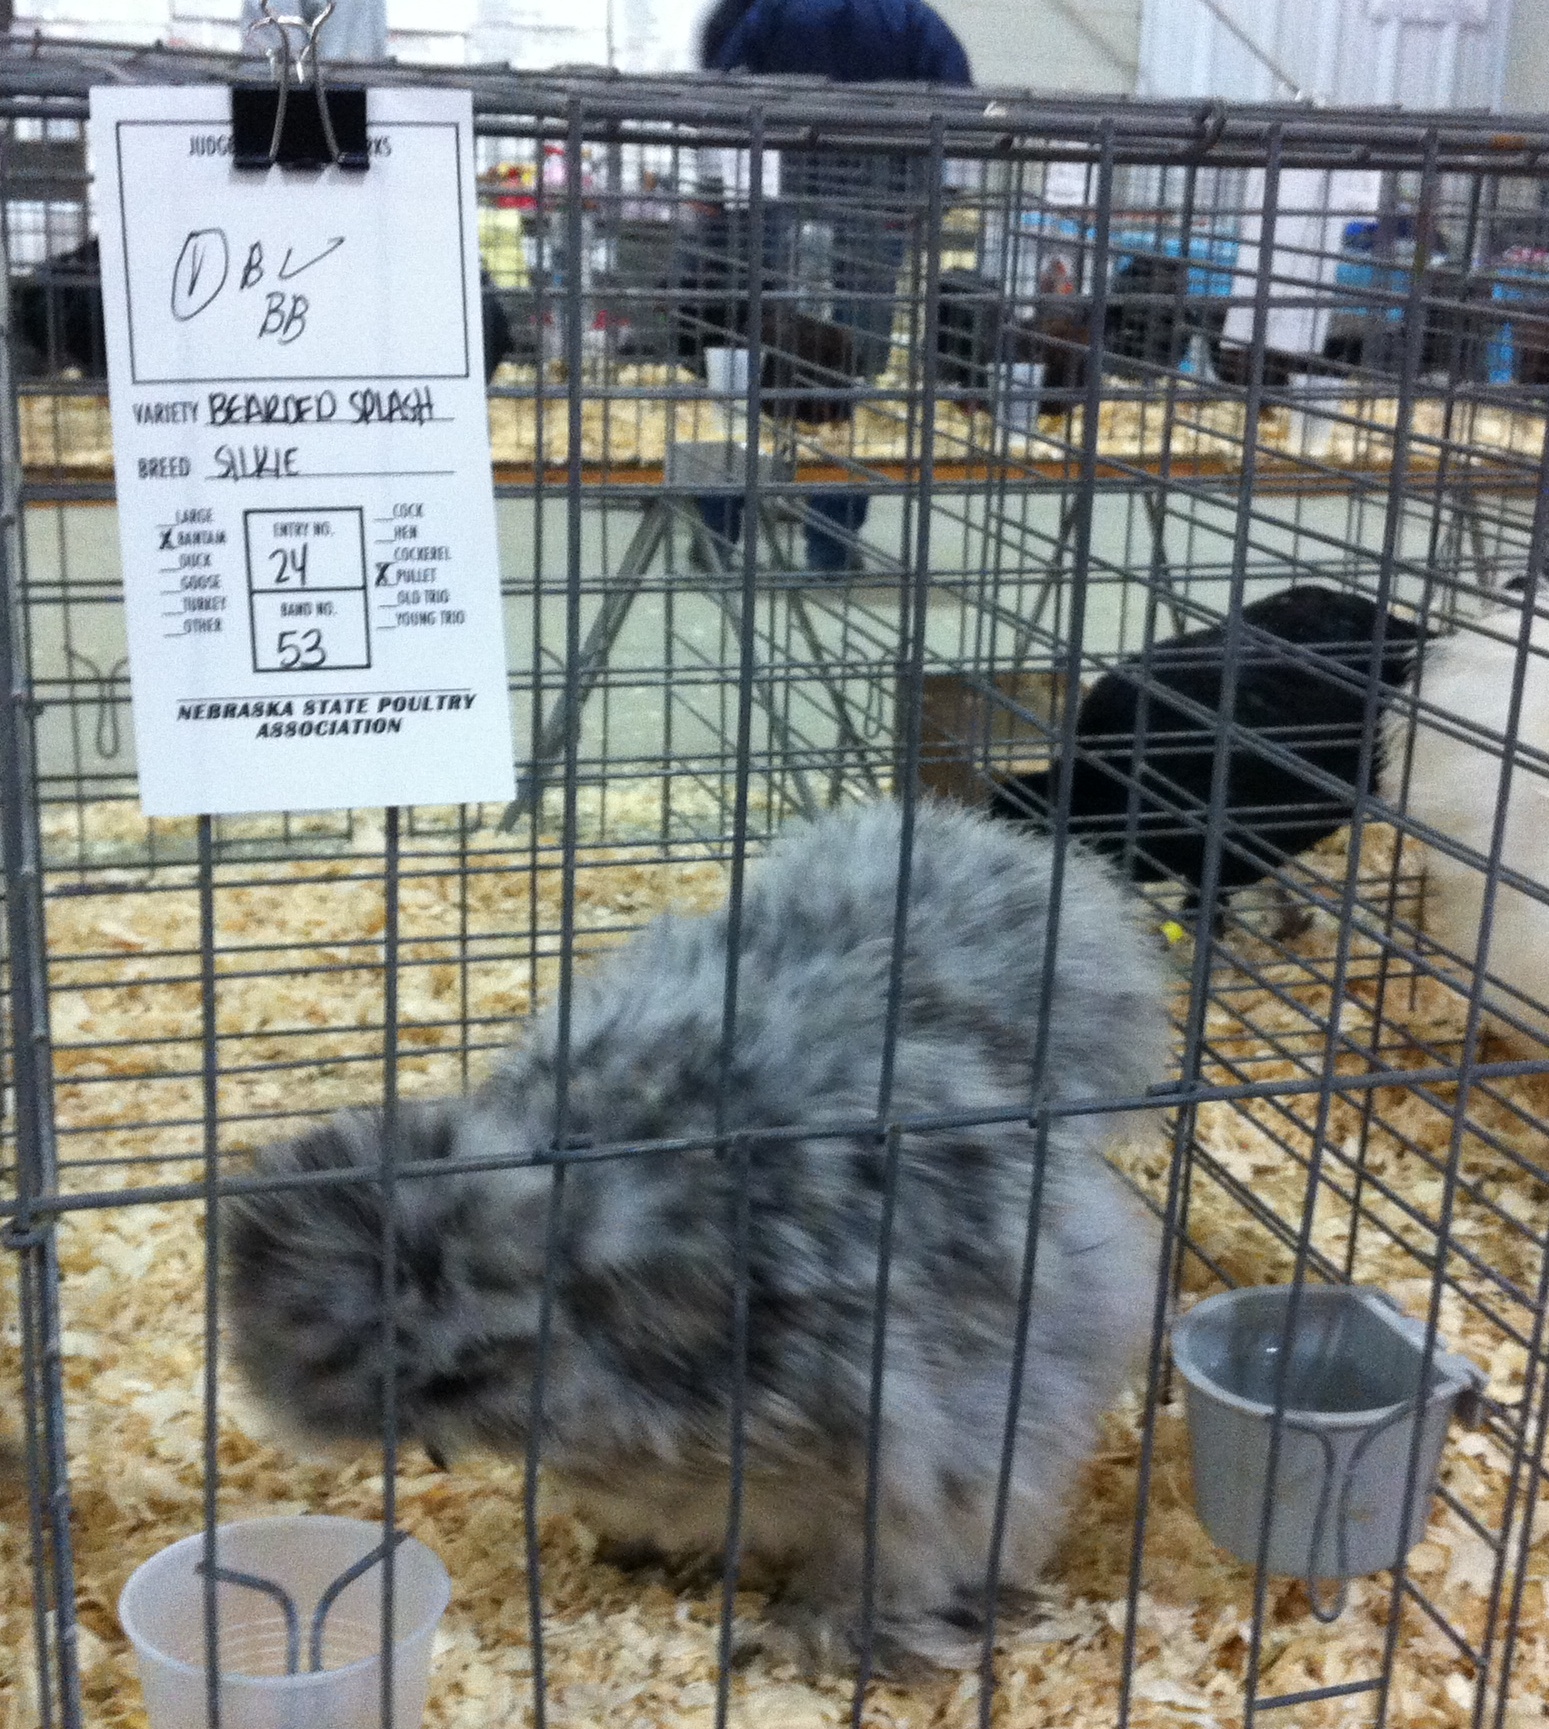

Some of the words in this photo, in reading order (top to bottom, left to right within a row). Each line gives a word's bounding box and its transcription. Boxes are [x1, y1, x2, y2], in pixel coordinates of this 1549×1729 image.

[258, 292, 309, 345] BB
[133, 402, 197, 424] VARIETY
[210, 392, 336, 426] BEARDED
[350, 387, 433, 426] SPLASH
[138, 458, 190, 478] BREED
[215, 445, 300, 480] SILKIE
[176, 509, 213, 523] LARGE
[393, 504, 423, 518] COCK
[274, 522, 310, 536] ENTRY
[394, 525, 417, 539] HEN
[178, 531, 226, 544] BANTAM
[179, 554, 211, 568] DUCK
[395, 547, 450, 561] COCKEREL
[269, 543, 309, 586] 24
[181, 575, 221, 589] GOOSE
[396, 568, 436, 583] PULLET
[183, 597, 226, 611] TURKEY
[398, 590, 422, 604] OLD
[425, 590, 449, 603] TRIO
[281, 603, 312, 616] BAND
[396, 611, 436, 626] YOUNG
[441, 610, 464, 624] TRIO
[184, 619, 222, 632] OTHER
[278, 628, 326, 668] 53
[177, 701, 294, 720] NEBRASKA
[303, 698, 369, 715] STATE
[378, 694, 477, 712] POULTRY
[256, 718, 402, 739] ASSOCIATION
